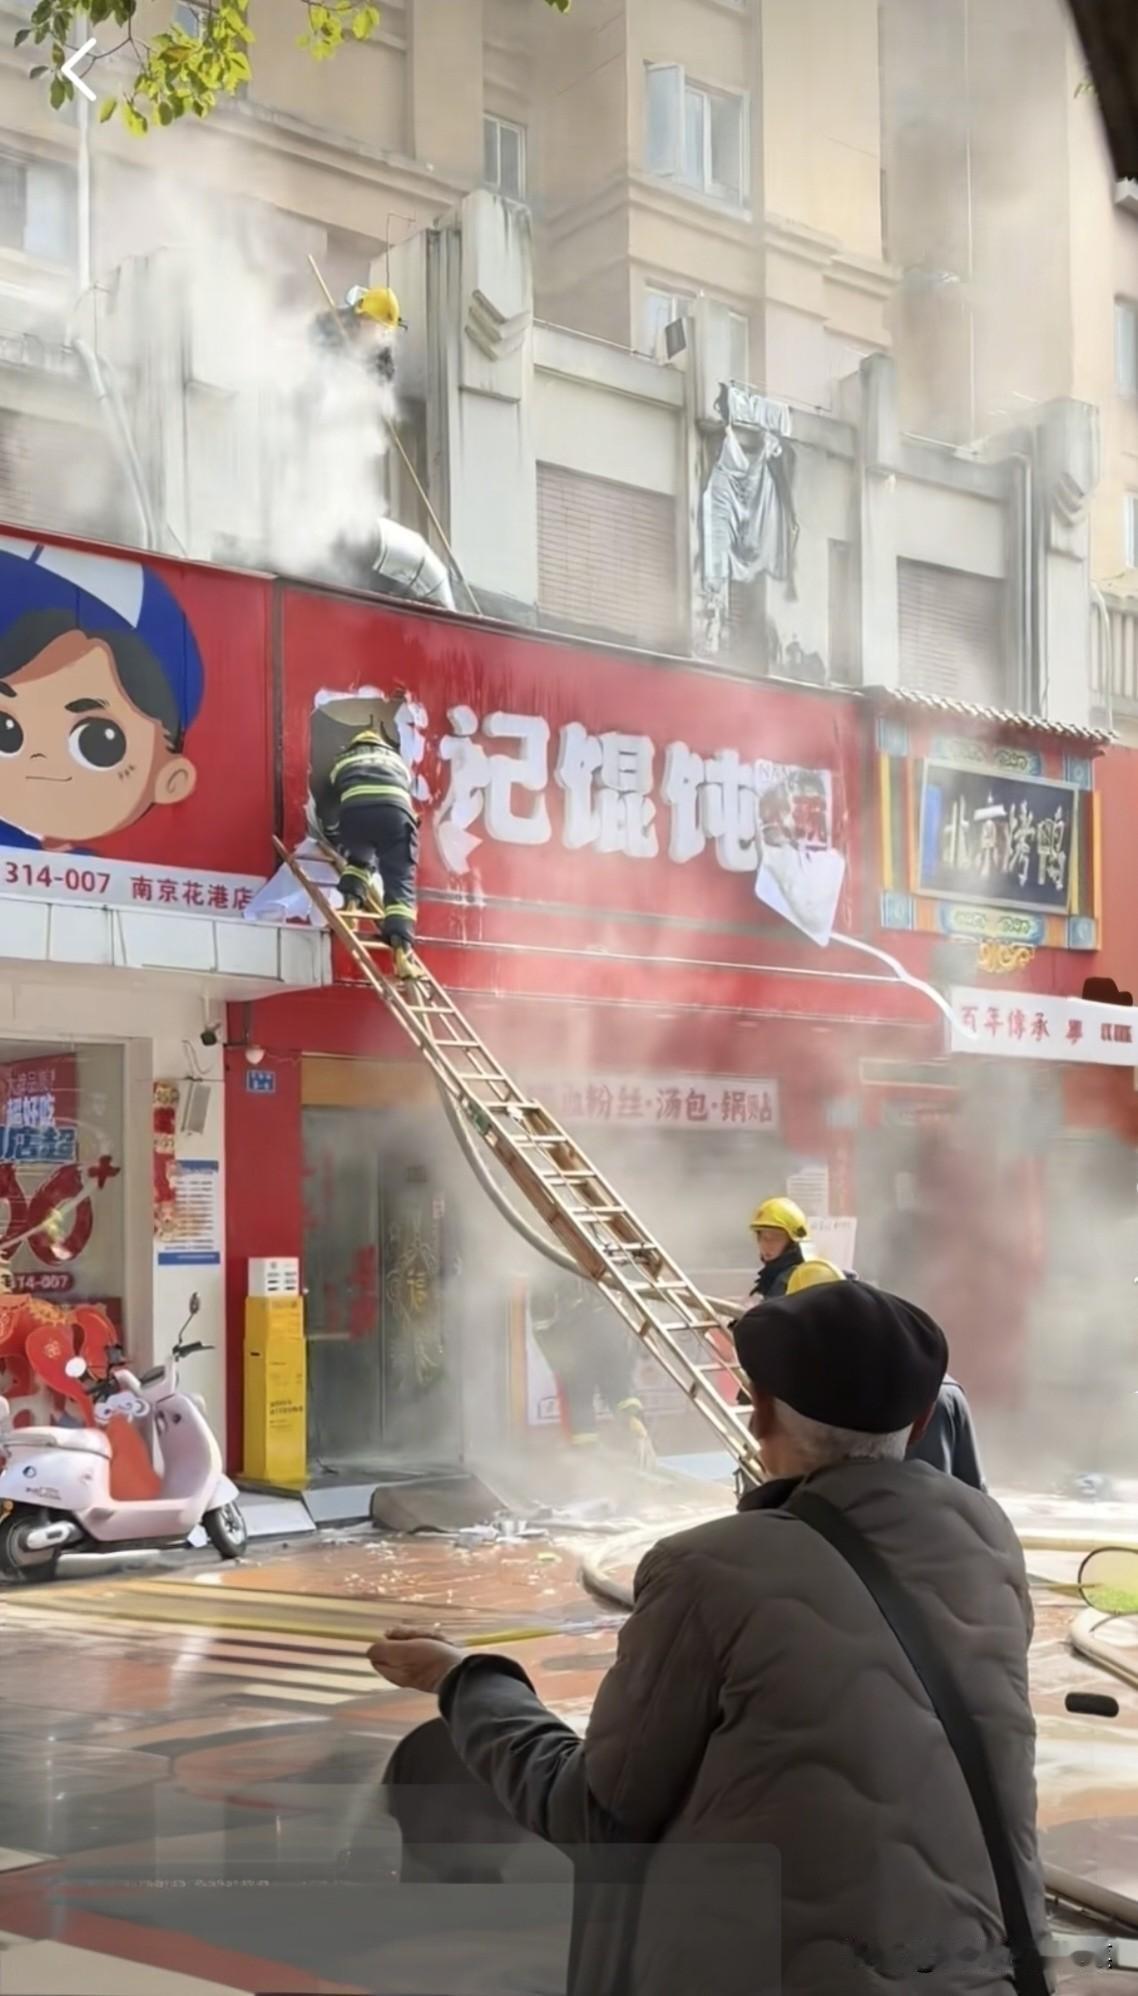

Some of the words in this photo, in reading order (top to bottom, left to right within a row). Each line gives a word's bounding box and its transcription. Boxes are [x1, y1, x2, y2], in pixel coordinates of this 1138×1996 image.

[393, 700, 760, 874] 记馄饨
[4, 861, 111, 894] 314-007
[129, 875, 254, 911] 南京花港店
